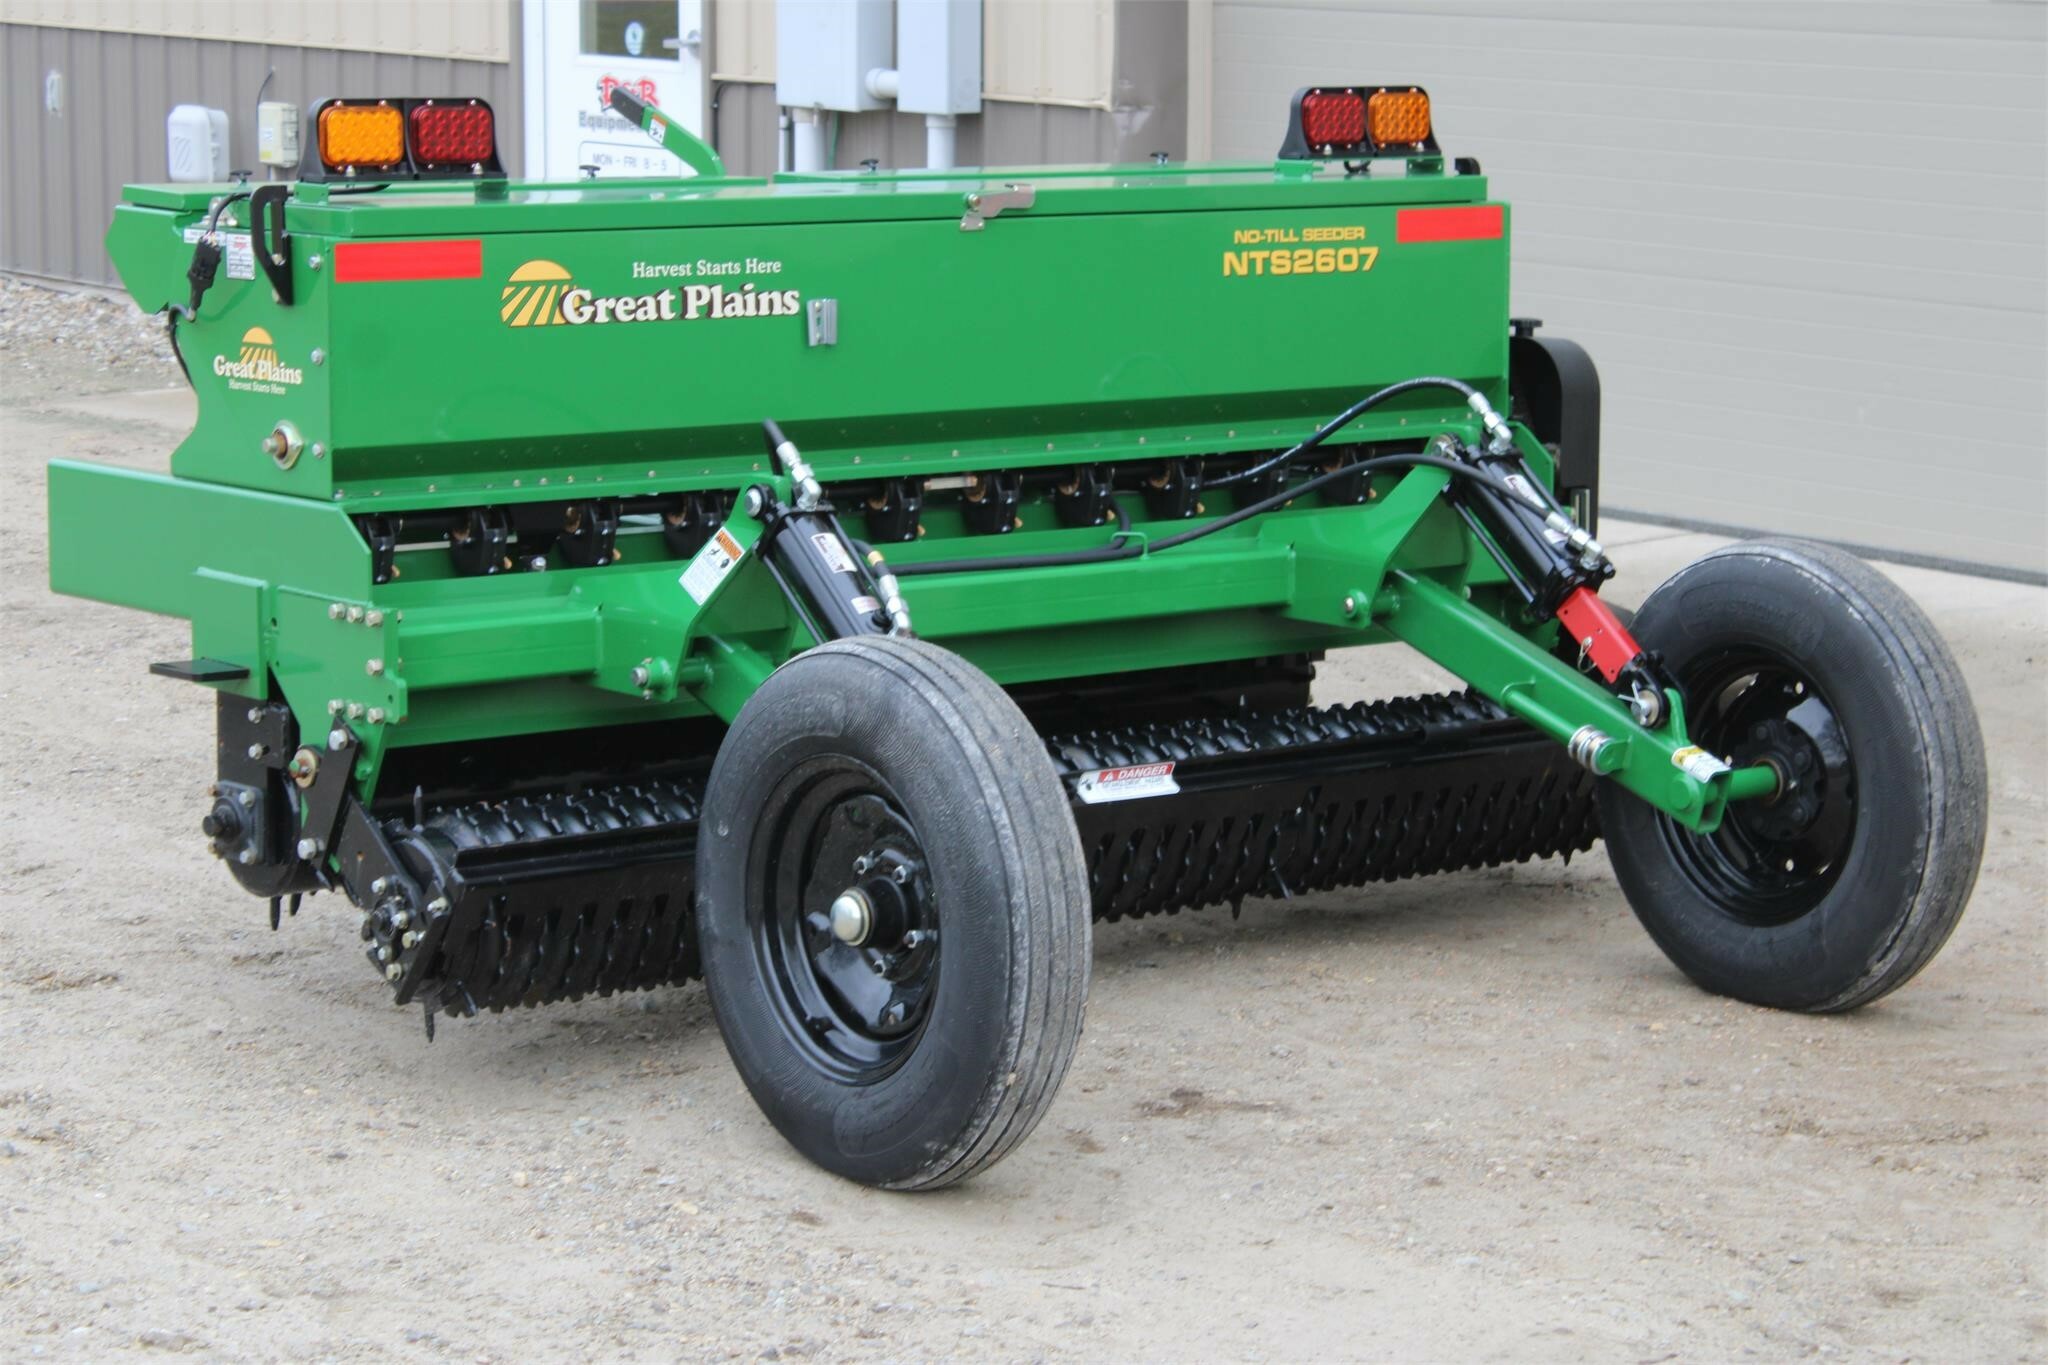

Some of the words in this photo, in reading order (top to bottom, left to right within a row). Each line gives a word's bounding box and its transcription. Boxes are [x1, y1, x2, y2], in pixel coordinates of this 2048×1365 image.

[1234, 228, 1300, 245] NO-TILL
[1302, 226, 1366, 242] SEEDER
[632, 261, 692, 279] Harvest
[696, 259, 742, 276] Starts
[746, 257, 783, 274] Here
[1223, 246, 1380, 277] NTS2607
[559, 286, 676, 326] Great
[682, 282, 801, 320] Plains
[213, 354, 256, 380] Great
[256, 358, 303, 385] Plains
[1118, 764, 1168, 780] DANGER
